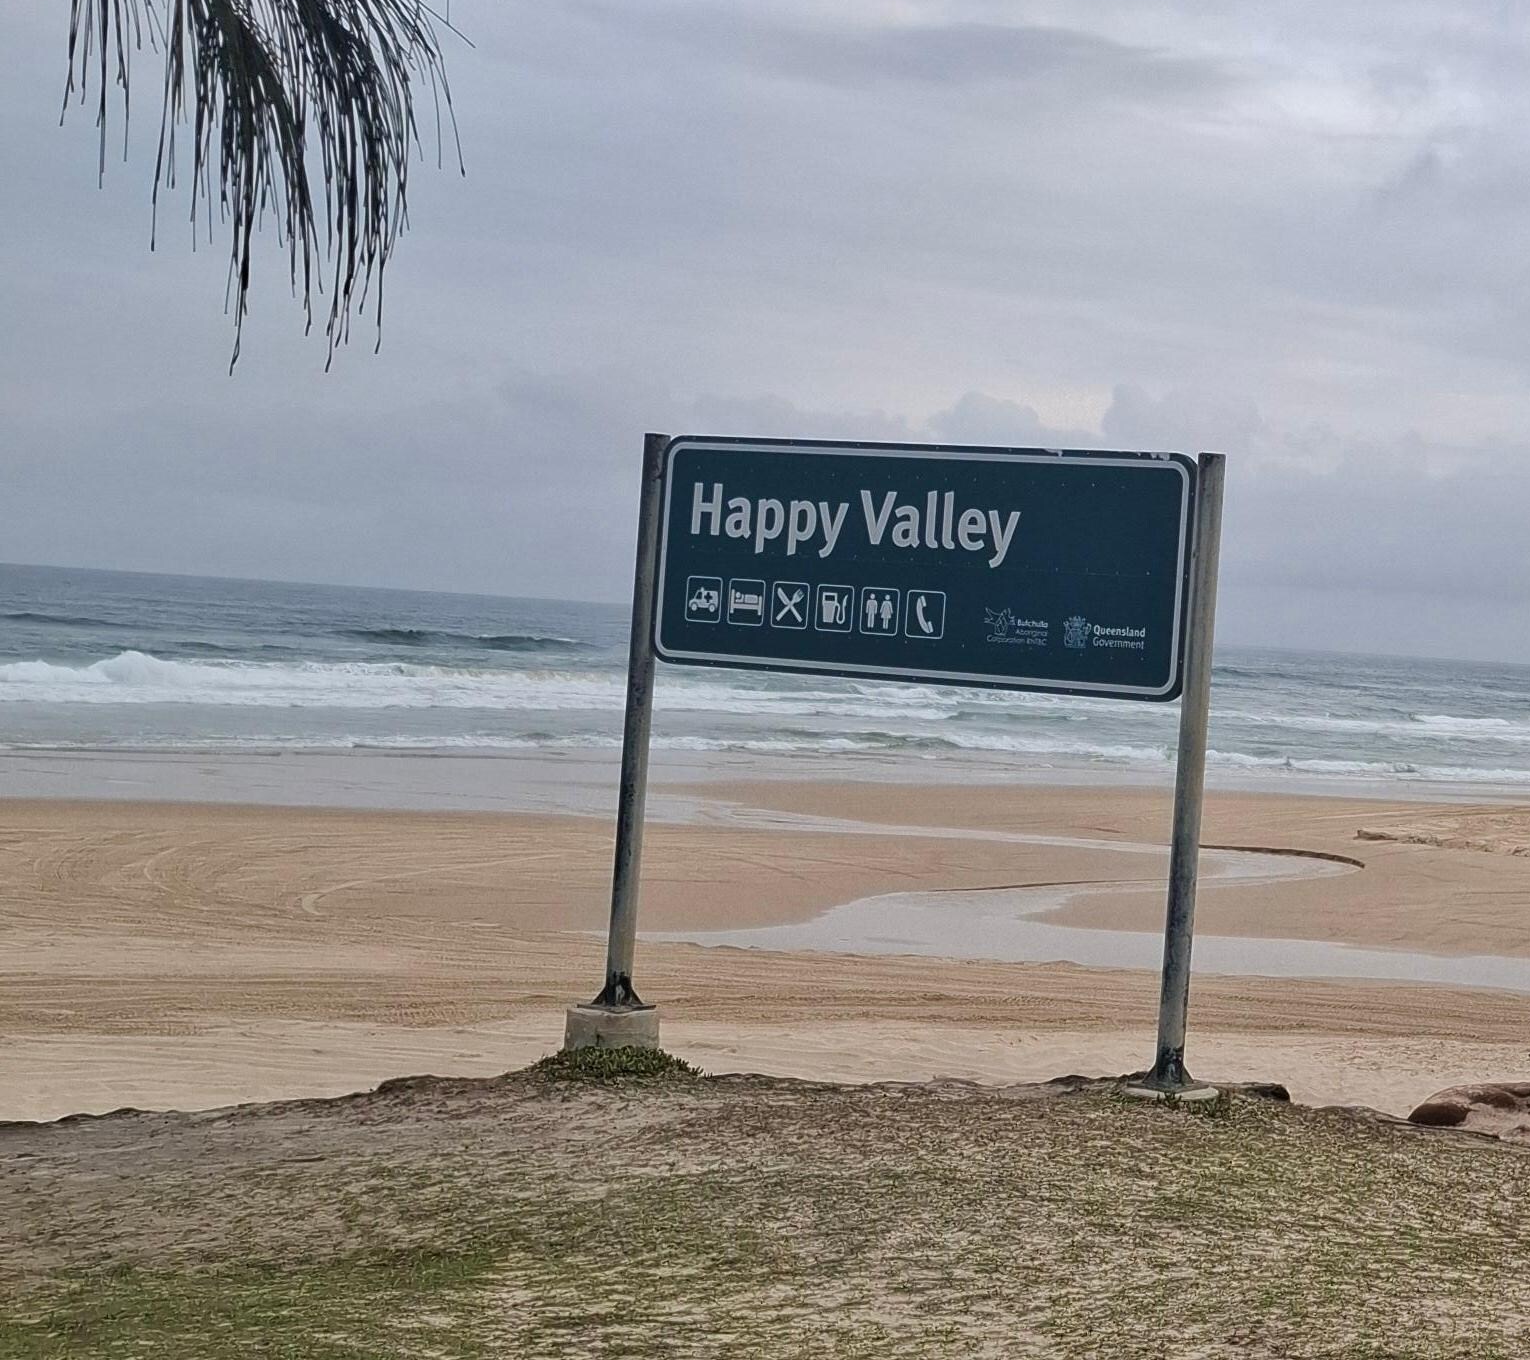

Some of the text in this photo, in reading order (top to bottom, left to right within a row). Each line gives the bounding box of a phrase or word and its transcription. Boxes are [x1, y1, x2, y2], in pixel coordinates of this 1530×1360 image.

[691, 482, 1021, 568] Happy Valley
[1093, 624, 1146, 637] Queensland
[1092, 636, 1145, 650] Government
